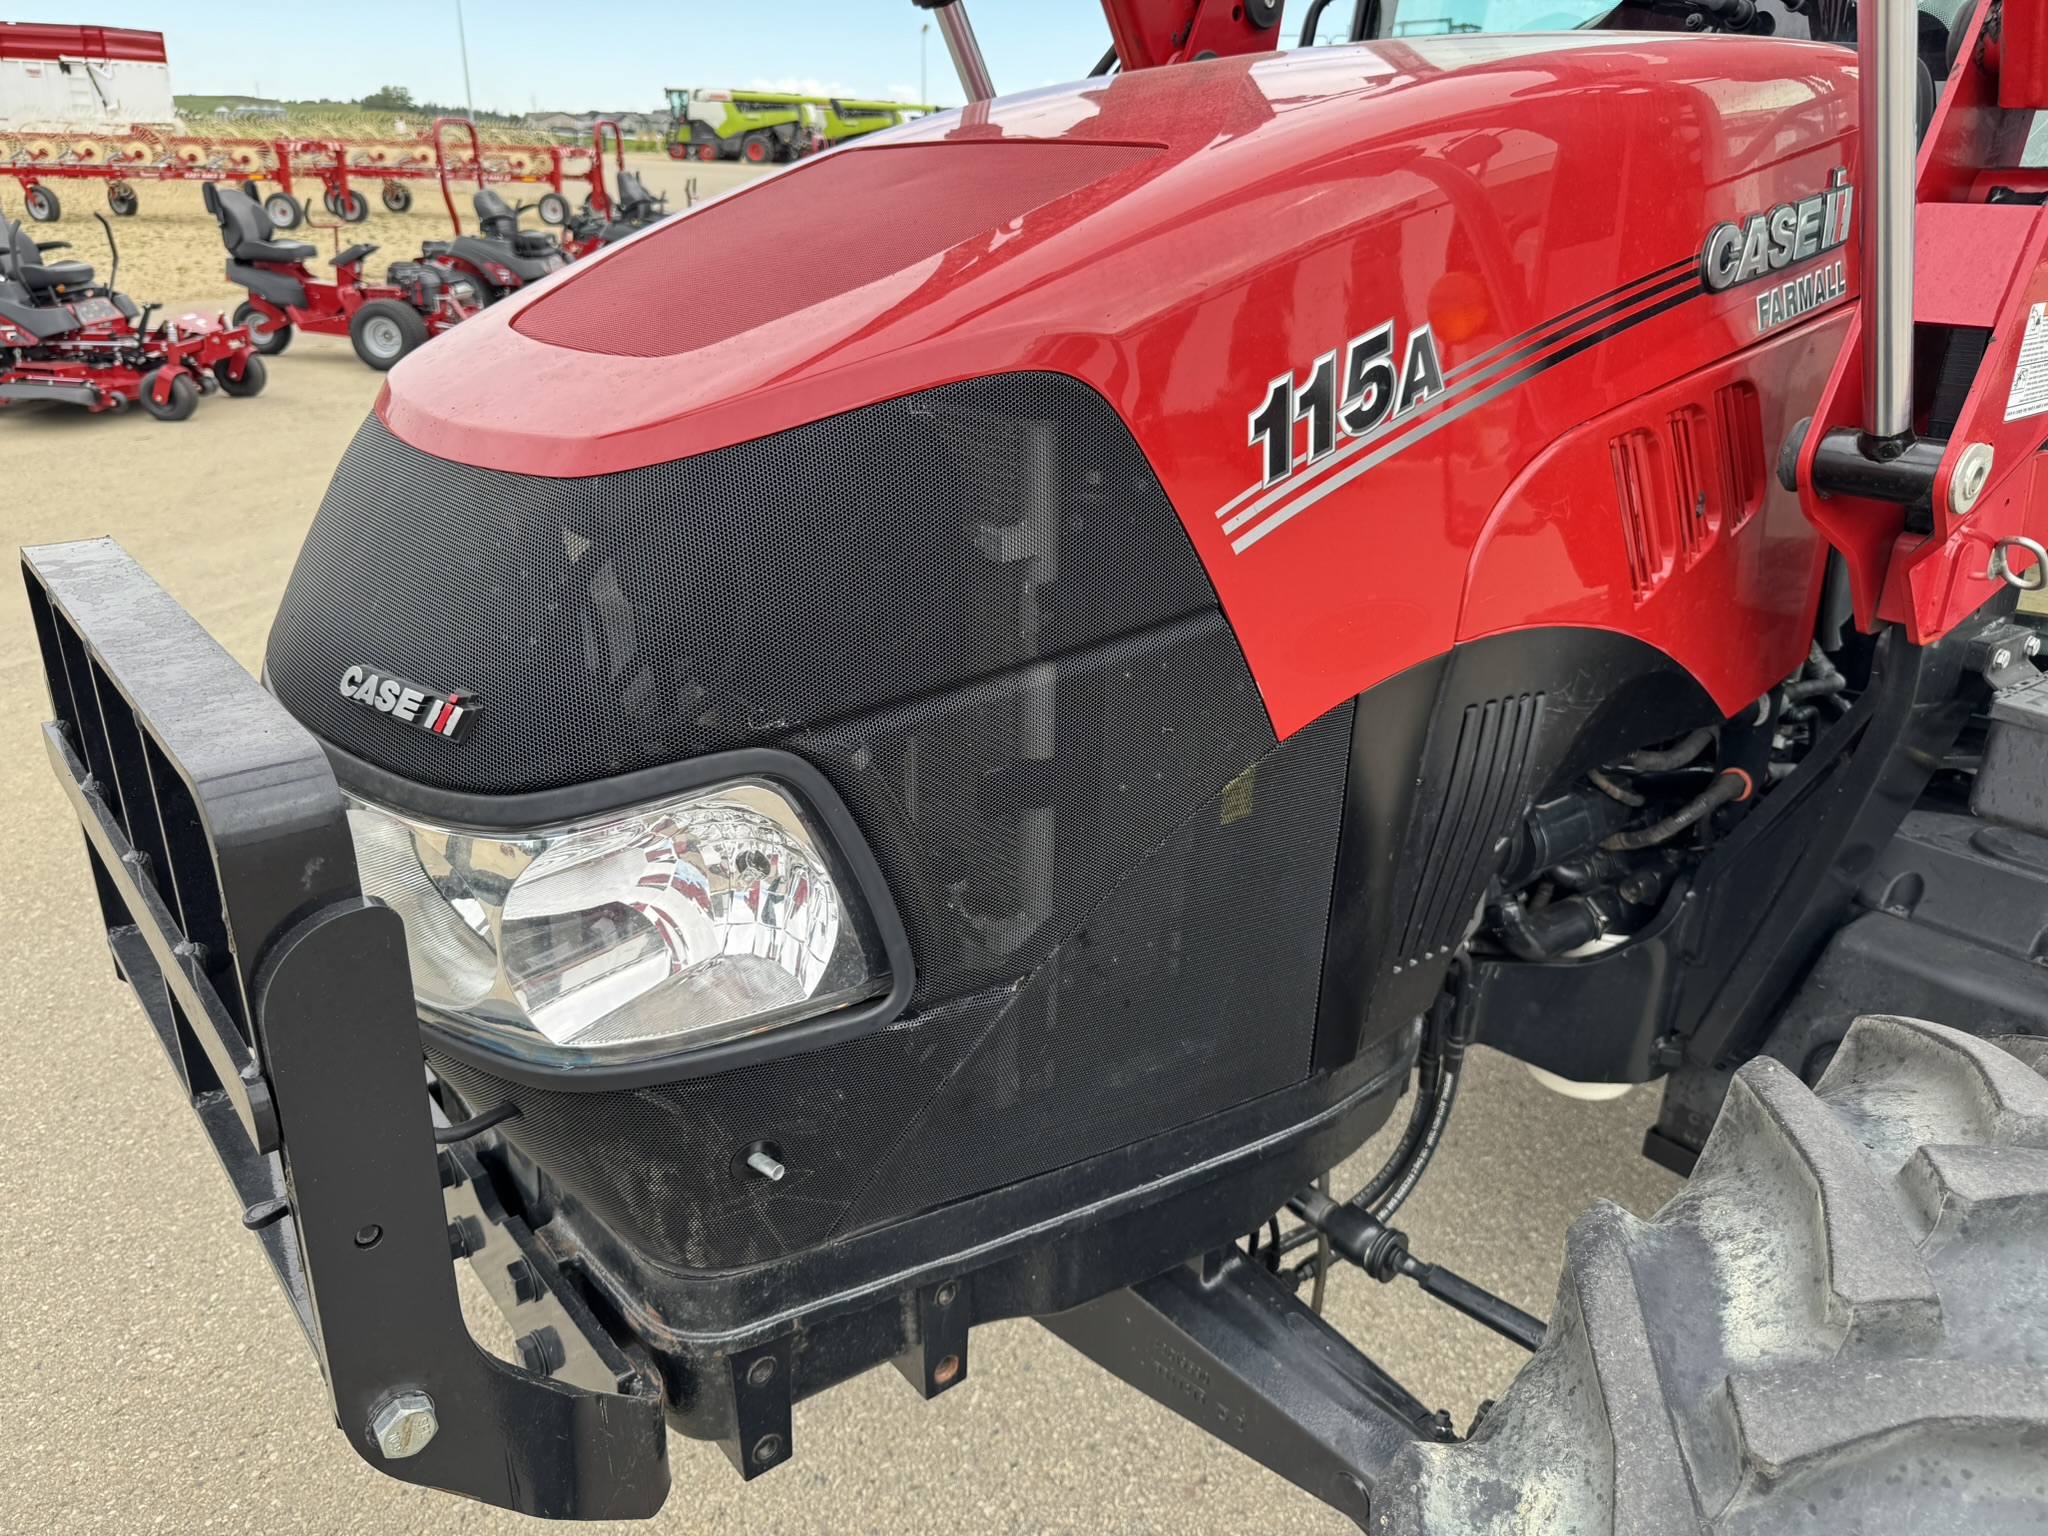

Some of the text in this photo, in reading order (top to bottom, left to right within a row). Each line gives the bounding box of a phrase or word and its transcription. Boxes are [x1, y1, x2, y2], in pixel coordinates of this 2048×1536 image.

[1705, 195, 1823, 291] CASE
[1756, 260, 1847, 333] FARMALL
[1247, 317, 1446, 491] 115A
[340, 665, 425, 722] CASE
